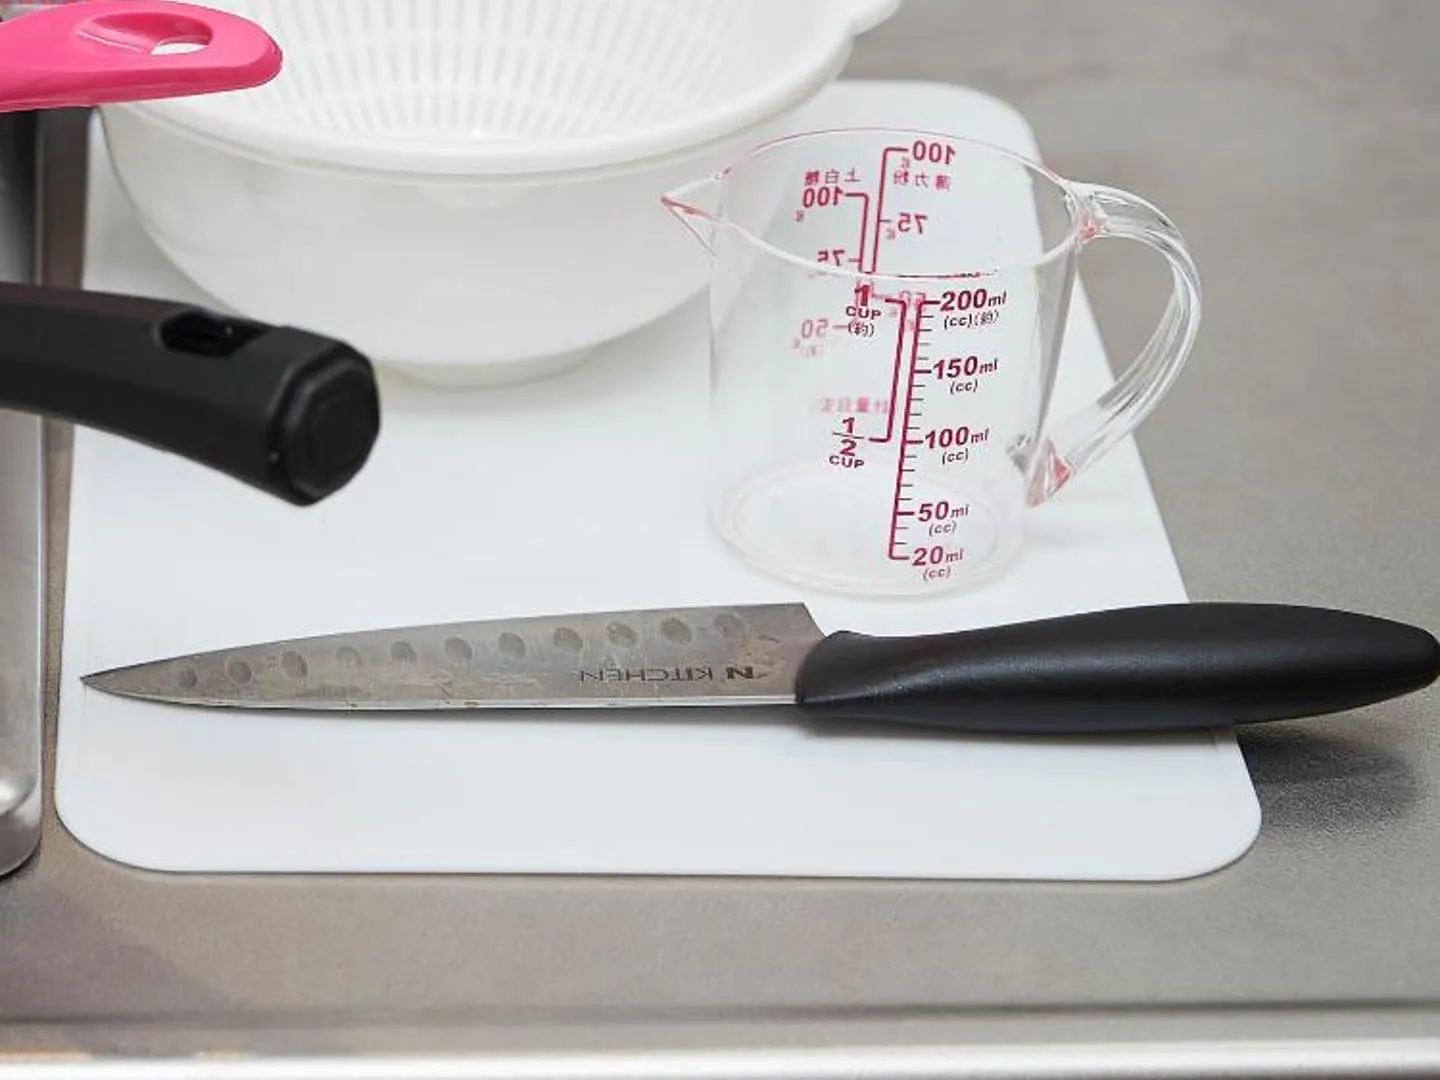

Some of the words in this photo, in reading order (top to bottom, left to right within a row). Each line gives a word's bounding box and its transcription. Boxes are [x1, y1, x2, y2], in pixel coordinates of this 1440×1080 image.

[940, 288, 1007, 312] 200ml
[845, 305, 882, 320] CUP
[932, 356, 998, 380] 150ml
[949, 379, 979, 395] (cc)
[924, 426, 990, 449] 100ml
[828, 455, 865, 469] CUP
[942, 448, 969, 466] (cc)
[918, 501, 970, 522] 50ml
[928, 521, 957, 537] (cc)
[912, 546, 965, 567] 20ml
[922, 566, 952, 582] (cc)
[580, 667, 713, 683] KITCHEN
[726, 666, 754, 680] N
